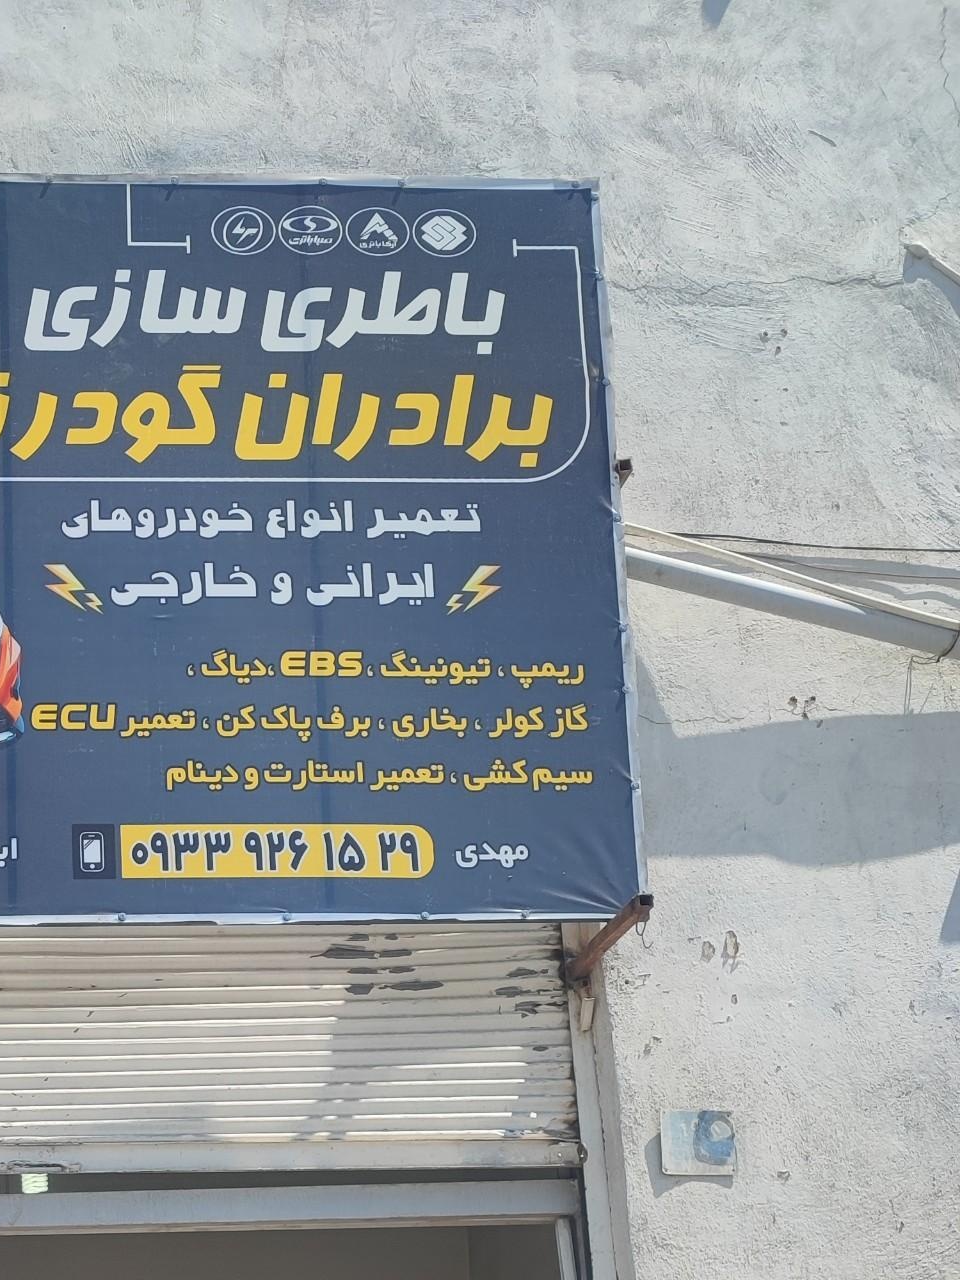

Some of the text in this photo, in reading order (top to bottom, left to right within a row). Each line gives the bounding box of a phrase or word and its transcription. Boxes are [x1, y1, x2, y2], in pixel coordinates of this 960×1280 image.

[24, 269, 506, 355] باطری سازی
[234, 373, 553, 468] برادران
[61, 500, 481, 539] تعمیر انواع خودروهای
[111, 562, 435, 606] ایرانی و خارجی
[280, 651, 363, 677] EBS
[380, 650, 491, 685] تیونینگ
[511, 662, 584, 689] ریمپ
[31, 704, 116, 730] ECU
[120, 710, 196, 737] تعمیر
[216, 705, 256, 737] کن
[261, 705, 311, 742] پاک
[317, 706, 371, 737] برف
[392, 708, 467, 738] بخاری
[488, 706, 544, 738] کولر
[550, 703, 588, 738] گاز
[166, 760, 239, 791] دینام
[244, 767, 259, 790] و
[264, 760, 364, 790] استارت
[369, 764, 444, 791] تعمیر
[463, 759, 528, 791] کشی
[532, 768, 593, 791] سیم
[131, 830, 419, 872] ۰۹۳۳ ۹۲۶ ۱۵ ۲۹
[455, 842, 529, 868] مهدی
